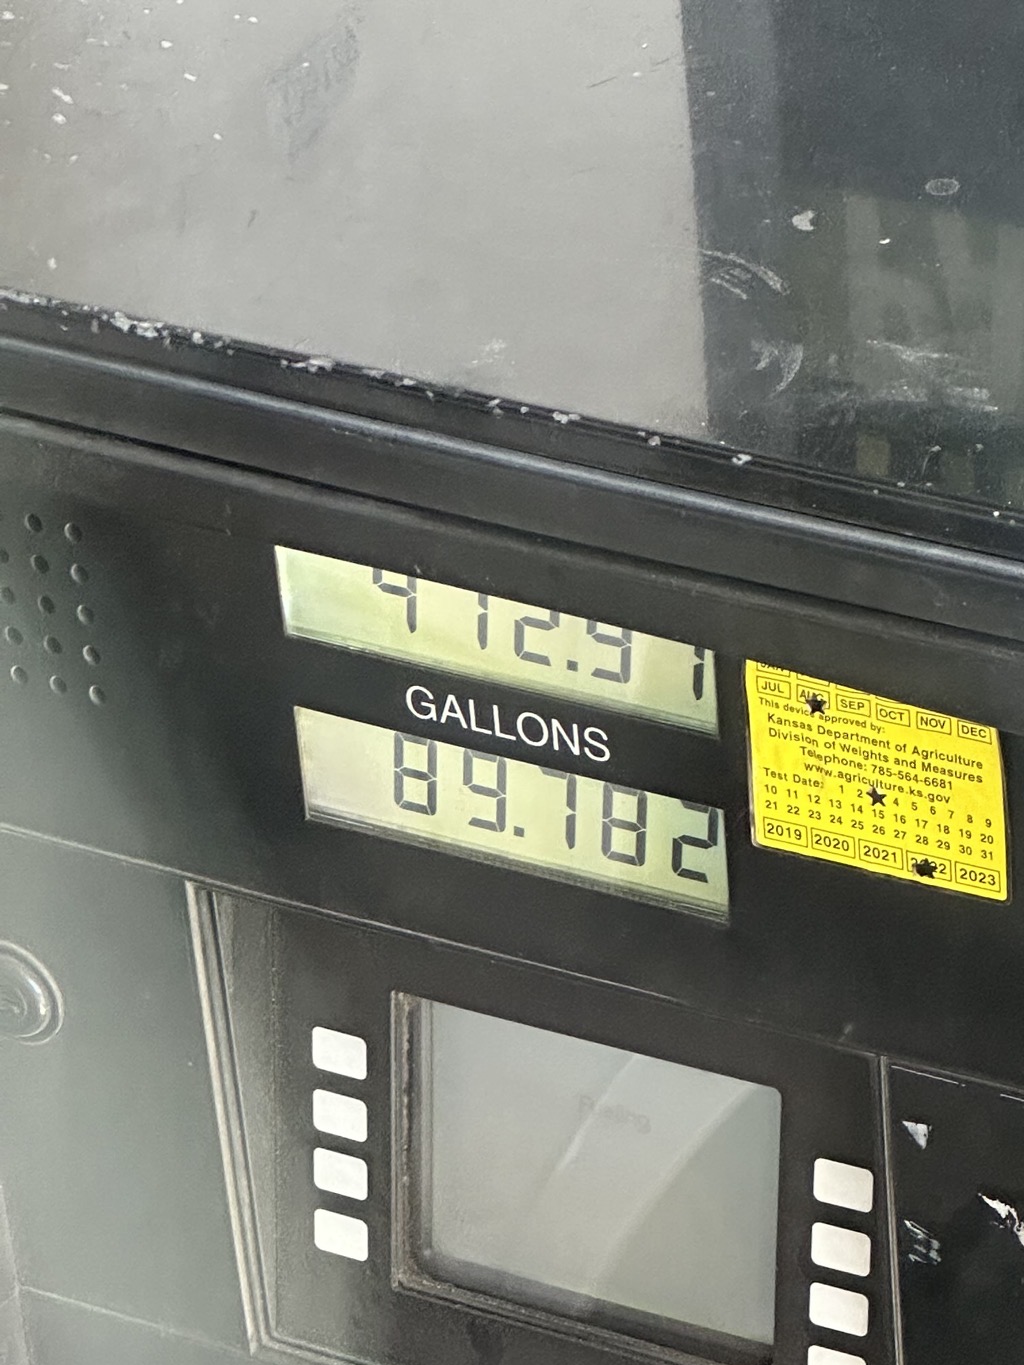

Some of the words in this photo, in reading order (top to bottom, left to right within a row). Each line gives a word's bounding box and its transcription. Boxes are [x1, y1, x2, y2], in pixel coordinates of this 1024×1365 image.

[761, 681, 784, 694] JUL
[840, 698, 865, 711] SEP
[406, 686, 610, 761] GALLONS
[759, 697, 779, 709] This
[819, 712, 866, 729] approved
[870, 722, 885, 734] by:
[880, 708, 905, 722] OCT
[920, 716, 947, 730] NOV
[768, 712, 812, 731] Kansas
[818, 725, 890, 749] Department
[895, 744, 906, 753] of
[912, 746, 982, 769] Agriculture
[961, 725, 987, 738] DEC
[769, 727, 818, 747] Division
[824, 741, 835, 750] of
[839, 743, 889, 762] Weights
[894, 758, 916, 769] and
[922, 762, 983, 783] Measures
[763, 767, 788, 781] Test
[793, 774, 824, 788] Date:
[800, 746, 867, 771] Telephone:
[872, 764, 952, 790] 785-564-6681
[804, 763, 950, 804] www.agriculture.ks.gov
[394, 732, 719, 883] 89.782
[767, 822, 802, 841] 2019
[814, 834, 850, 852] 2020
[863, 846, 898, 864] 2021
[960, 868, 996, 887] 2023
